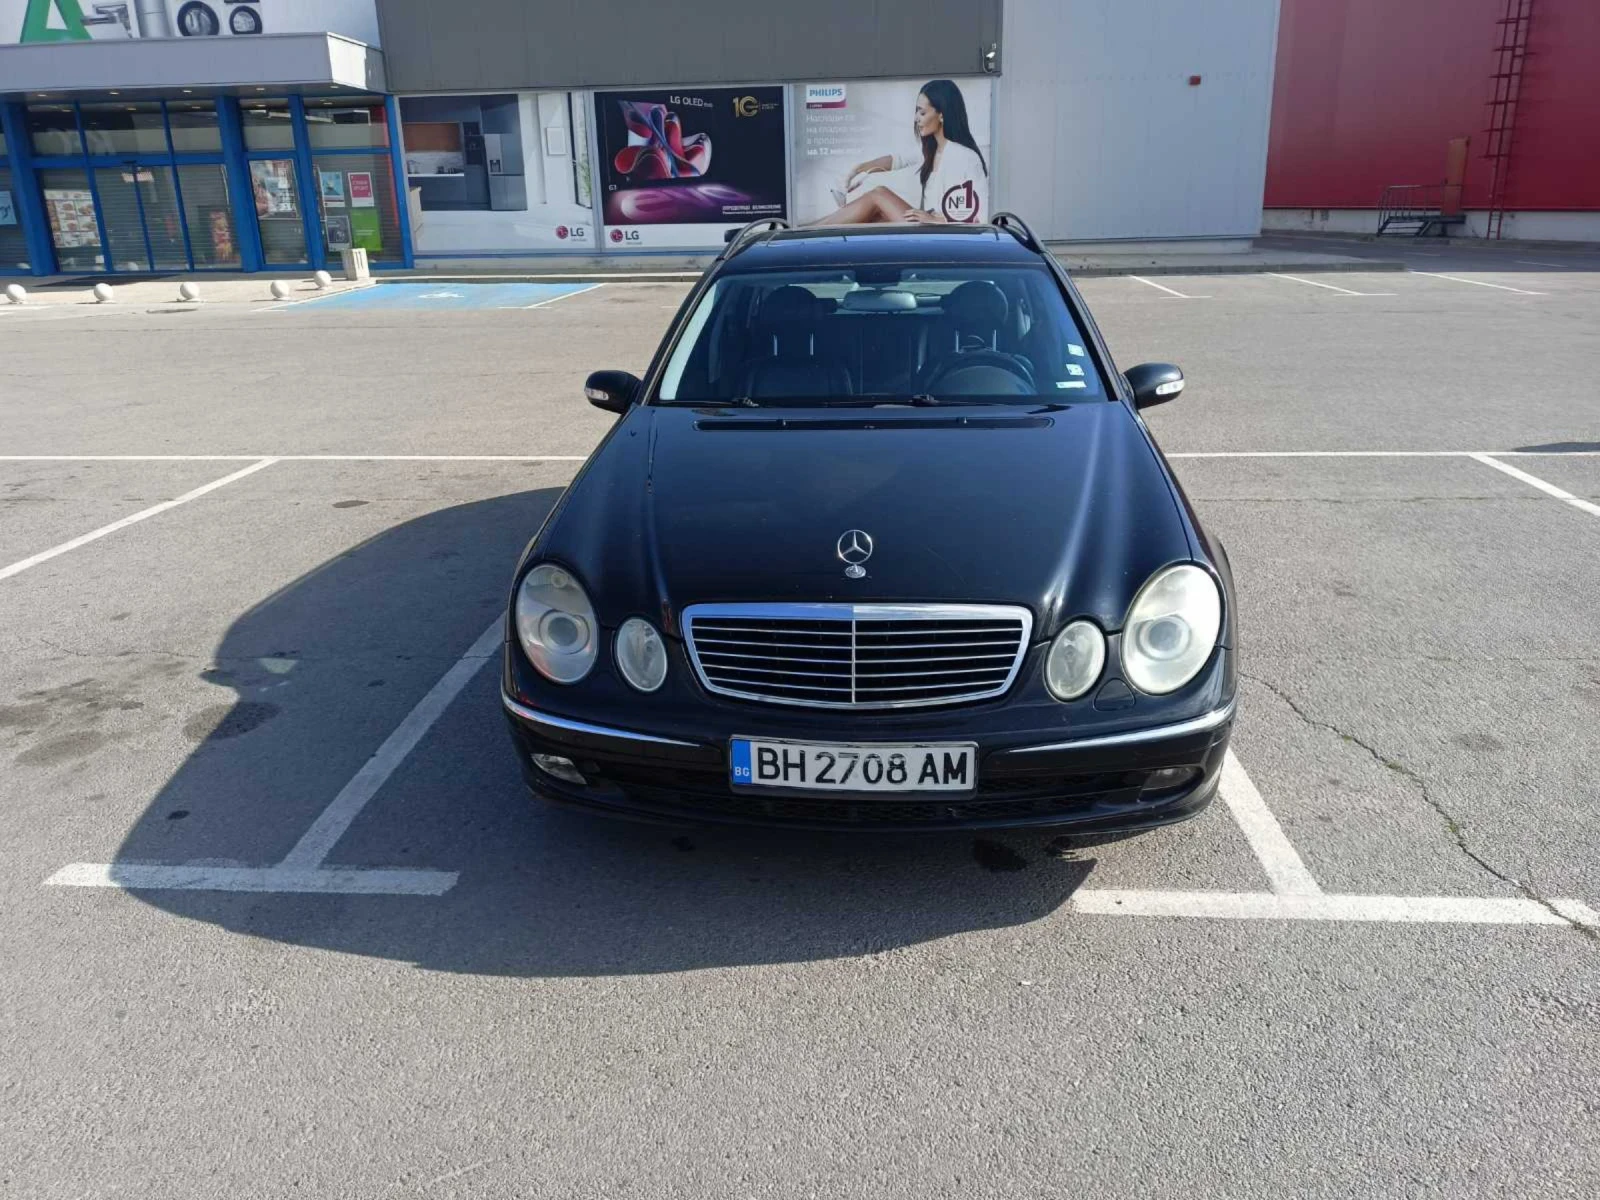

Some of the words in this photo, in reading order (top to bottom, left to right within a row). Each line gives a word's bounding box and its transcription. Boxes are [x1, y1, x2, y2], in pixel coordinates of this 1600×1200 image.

[809, 88, 843, 97] PHILIPS
[670, 95, 681, 105] LG
[682, 97, 704, 107] OLED
[569, 228, 584, 237] LG
[625, 231, 639, 240] LG
[757, 747, 806, 782] BH
[814, 751, 908, 785] 2708
[917, 752, 967, 785] AM
[734, 766, 750, 776] BG
